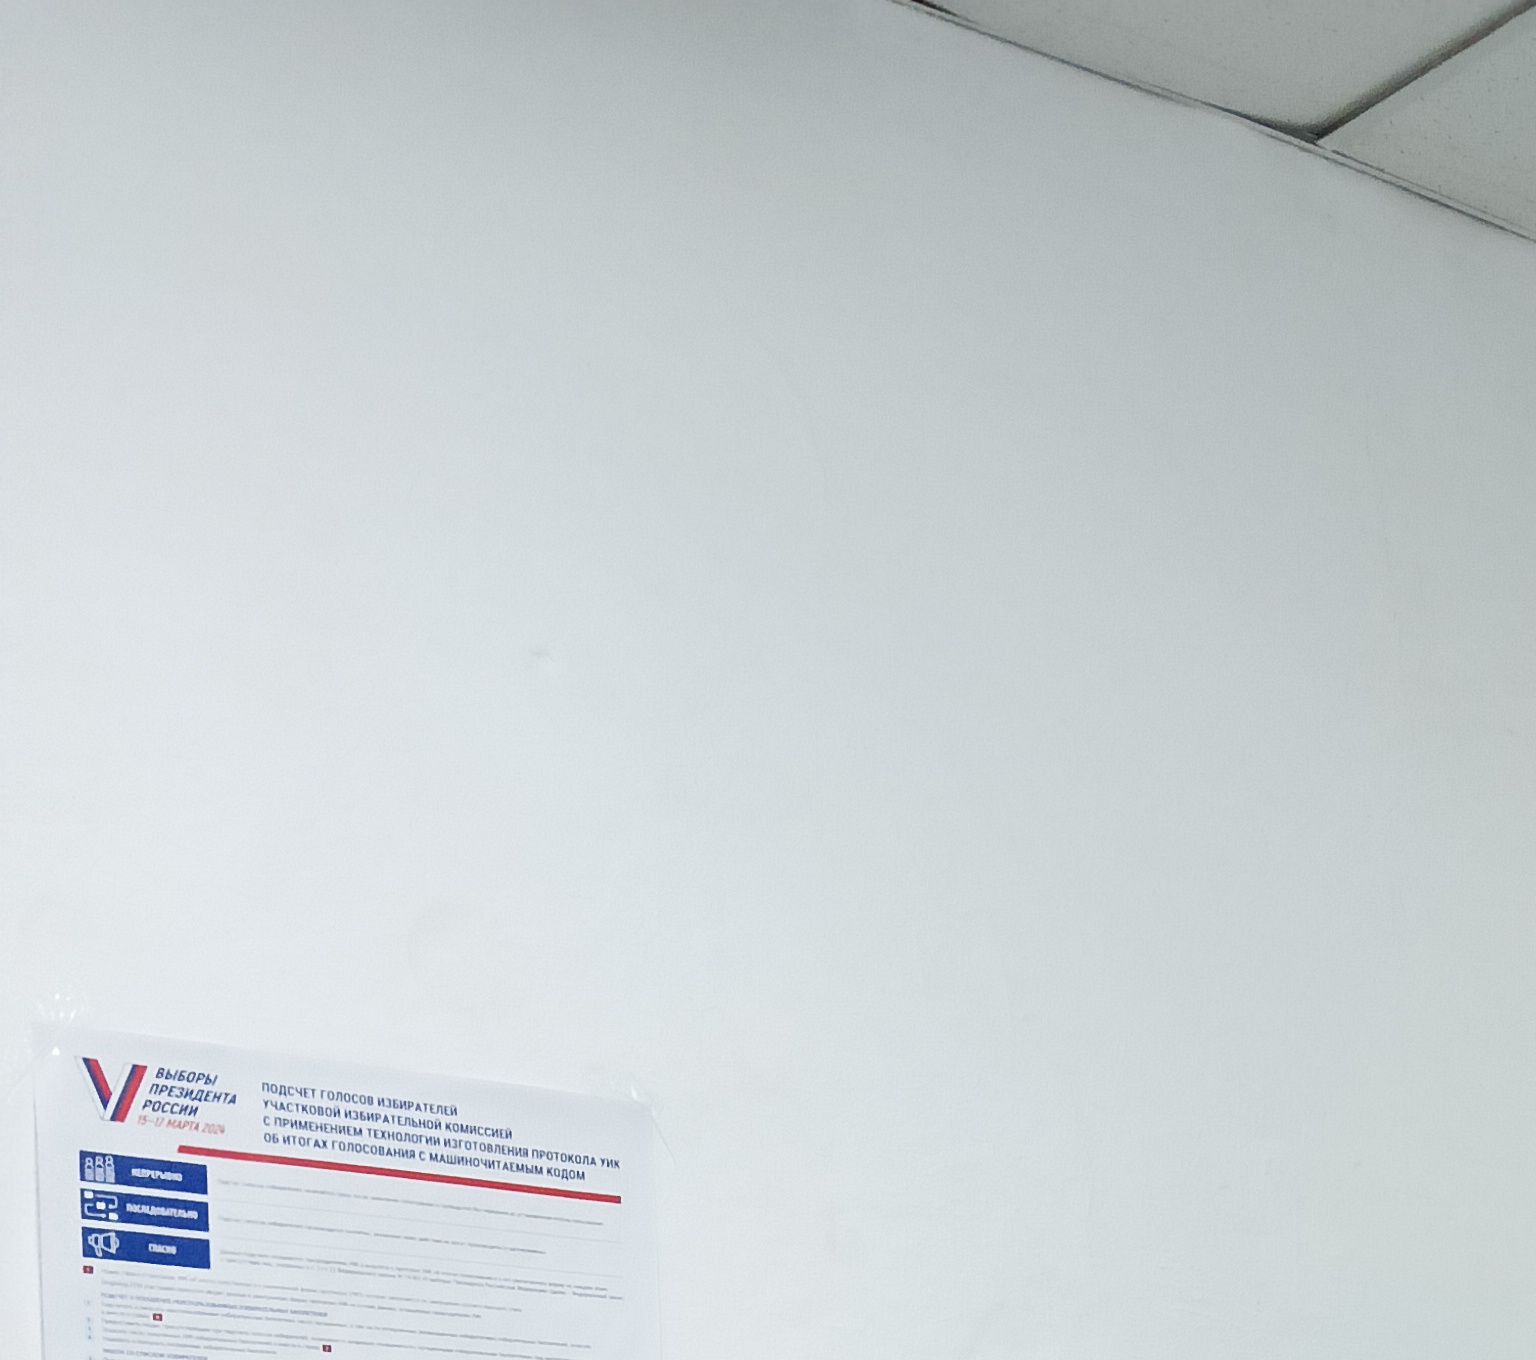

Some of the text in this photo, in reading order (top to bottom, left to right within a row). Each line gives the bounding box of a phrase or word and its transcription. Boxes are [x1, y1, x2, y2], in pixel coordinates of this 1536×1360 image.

[155, 1067, 219, 1086] ВЫБОРЫ
[149, 1083, 237, 1105] ПРЕЗИДЕНТА
[261, 1082, 458, 1116] ПОДСЧЕТ ГОЛОСОВ ИЗБИРАТЕЛЕЙ
[142, 1100, 199, 1117] РОССИИ
[262, 1099, 513, 1140] УЧАСТКОВОЙ ИЗБИРАТЕЛЬНОЙ КОМИССИЕЙ
[165, 1119, 200, 1132] МАРТА
[202, 1122, 226, 1135] 2024
[263, 1116, 621, 1169] С ПРИМЕНЕНИЕМ ТЕХНОЛОГИИ ИЗГОТОВЛЕНИЯ ПРОТОКОЛА УИК
[263, 1132, 586, 1181] ОБ ИТОГАХ ГОЛОСОВАНИЯ С МАШИНОЧИТАЕМЫМ КОДОМ
